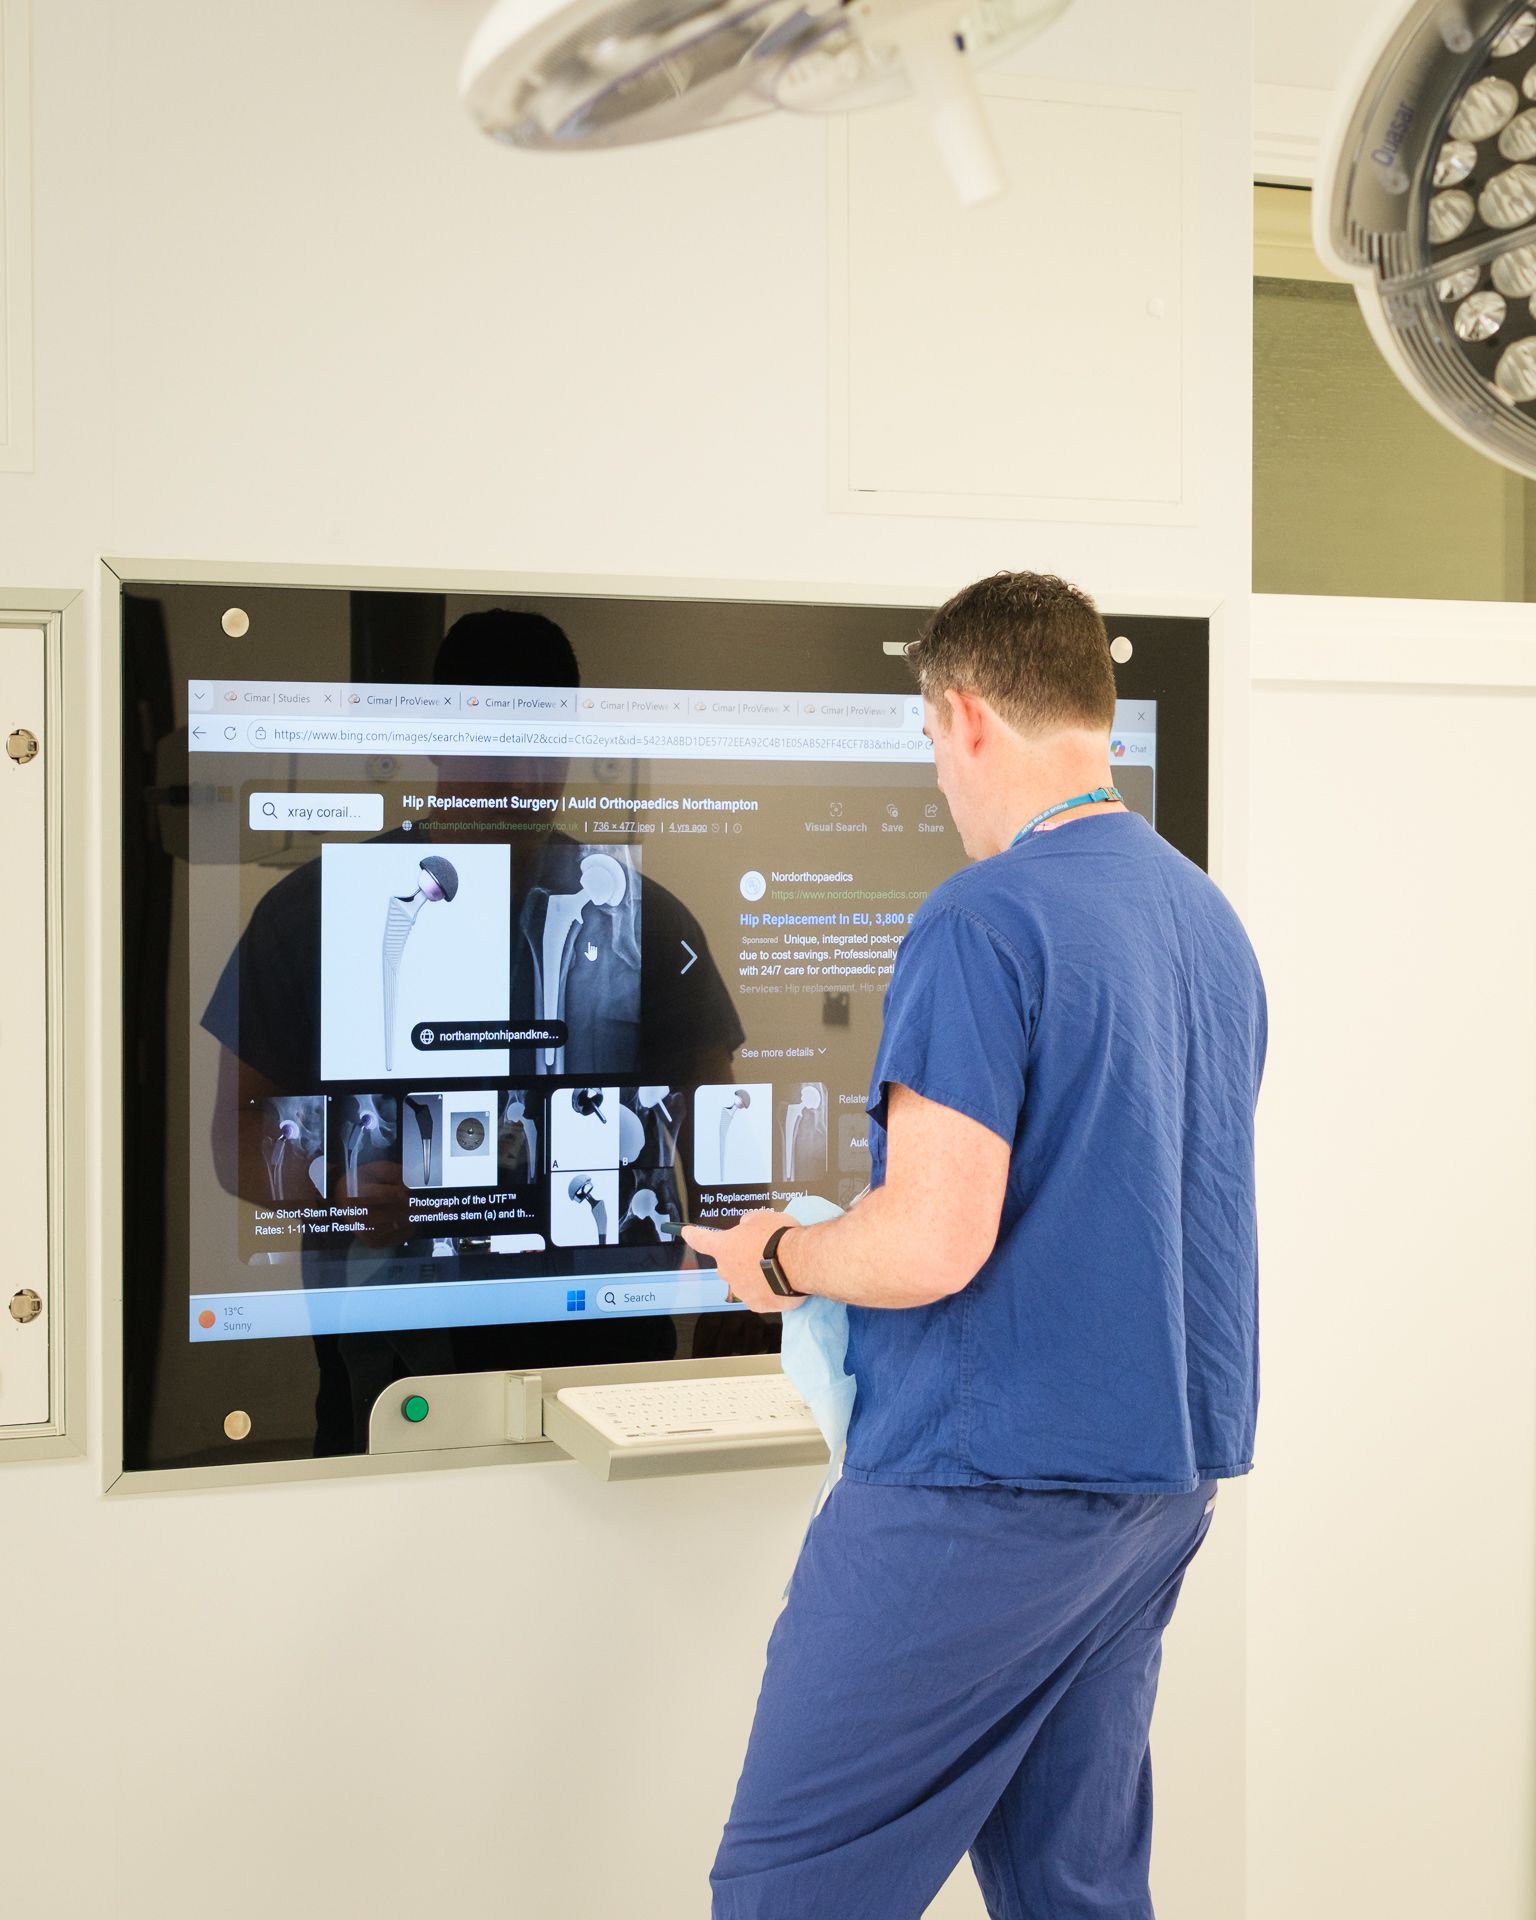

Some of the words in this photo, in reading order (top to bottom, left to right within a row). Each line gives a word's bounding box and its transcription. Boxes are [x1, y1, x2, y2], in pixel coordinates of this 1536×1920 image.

[1371, 101, 1414, 167] Quasar
[244, 692, 270, 702] Cimar
[278, 694, 311, 704] Studies
[367, 696, 392, 705] Cimar
[485, 698, 511, 708] Cimar
[600, 700, 625, 710] Cimar
[712, 703, 736, 713] Cimar
[821, 705, 844, 715] Cimar
[1130, 745, 1147, 753] Chat
[402, 795, 424, 810] Hip
[428, 796, 508, 810] Replacement
[511, 796, 559, 812] Surgery
[568, 797, 596, 809] Auld
[600, 797, 679, 812] Orthopaedics
[683, 798, 758, 813] Northampton
[1050, 803, 1068, 813] Proud
[288, 807, 314, 820] xray
[419, 821, 579, 832] northamptonhipandkneesurgery.co.uk
[593, 822, 610, 831] 736
[619, 822, 635, 831] 477
[637, 822, 656, 833] jpeg
[669, 822, 674, 831] 4
[676, 824, 691, 833] yrs
[692, 824, 708, 833] ago
[805, 823, 834, 833] Visual
[836, 823, 867, 833] Search
[881, 824, 904, 833] Save
[918, 823, 944, 833] Share
[772, 872, 853, 884] Nordorthopaedics
[772, 890, 928, 902] https://www.nordorthopaedics.com
[740, 914, 760, 928] Hip
[762, 914, 837, 928] Replacement
[839, 913, 850, 925] In
[853, 913, 873, 926] EU,
[876, 913, 905, 926] 3,800
[742, 936, 779, 945] Sponsored
[784, 934, 820, 947] Unique,
[822, 934, 868, 946] integrated
[871, 934, 904, 946] post-op
[740, 950, 758, 960] due
[760, 950, 769, 960] to
[771, 950, 792, 960] cost
[793, 949, 832, 962] savings.
[834, 949, 897, 961] Professionally
[739, 966, 759, 976] with
[761, 965, 782, 976] 24/7
[784, 967, 805, 976] care
[807, 965, 820, 975] for
[822, 964, 876, 977] orthopaedic
[739, 984, 783, 994] Services:
[785, 984, 800, 995] Hip
[860, 984, 874, 994] Hip
[440, 1029, 559, 1042] northamptonhipandkne...
[741, 1049, 759, 1058] See
[762, 1049, 783, 1058] more
[786, 1048, 814, 1057] details
[552, 1160, 559, 1169] A
[622, 1157, 629, 1166] B
[409, 1196, 460, 1208] Photograph
[462, 1195, 472, 1205] of
[472, 1195, 487, 1205] the
[700, 1194, 715, 1205] Hip
[716, 1192, 770, 1204] Replacement
[255, 1211, 274, 1220] Low
[276, 1208, 328, 1219] Short-Stem
[330, 1206, 368, 1217] Revision
[409, 1212, 459, 1223] cementless
[460, 1211, 482, 1220] stem
[484, 1210, 497, 1221] (a)
[498, 1209, 515, 1219] and
[700, 1208, 719, 1218] Auld
[255, 1226, 285, 1236] Rates:
[287, 1224, 306, 1234] 1-11
[309, 1224, 330, 1233] Year
[624, 1292, 656, 1303] Search
[224, 1306, 244, 1316] 13°C
[224, 1322, 252, 1332] Sunny
